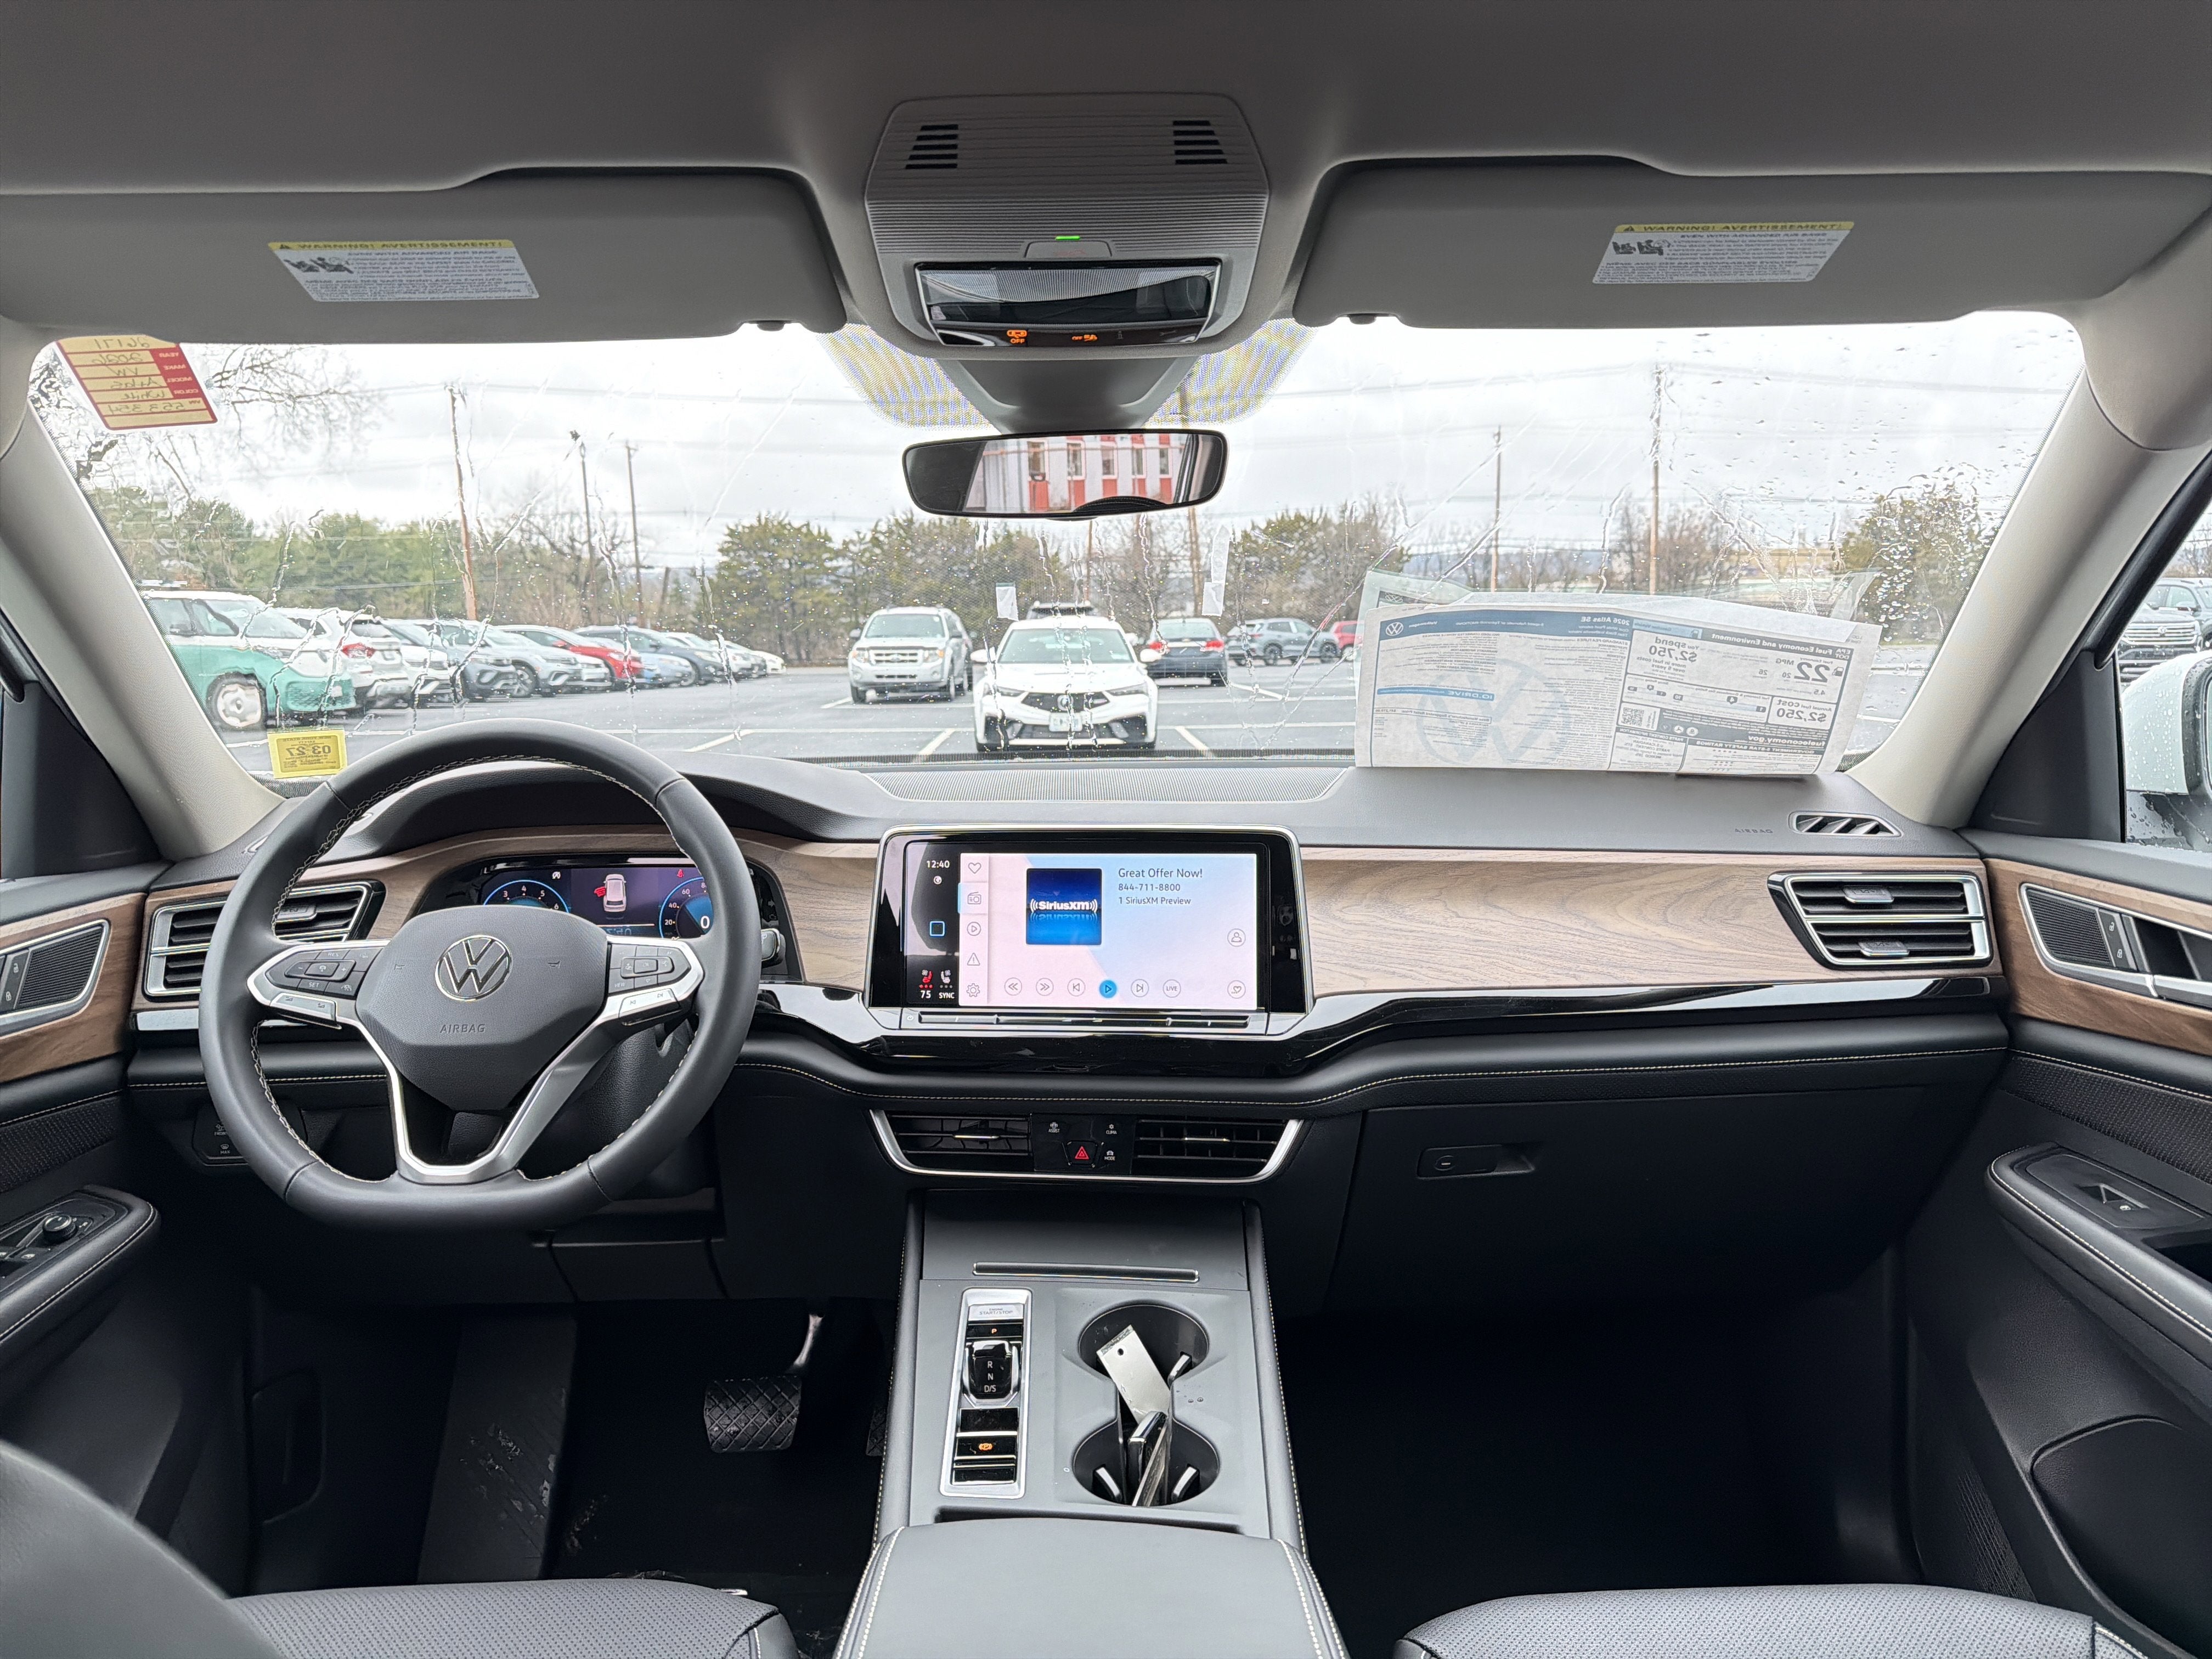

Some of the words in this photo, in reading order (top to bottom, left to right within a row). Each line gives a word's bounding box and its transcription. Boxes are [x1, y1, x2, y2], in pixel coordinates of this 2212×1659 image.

[926, 860, 950, 868] 12:40
[1118, 867, 1144, 878] Great
[1147, 867, 1174, 878] Offer
[1177, 867, 1203, 878] Now!
[1118, 883, 1181, 892] 844-711-8800
[1125, 897, 1159, 905] SiriusXM
[1160, 897, 1192, 905] Preview
[700, 915, 710, 929] 0
[920, 990, 932, 999] 75
[439, 1023, 486, 1034] AIRBAG
[988, 1361, 994, 1369] R
[988, 1373, 994, 1381] N
[984, 1385, 997, 1393] D/S
